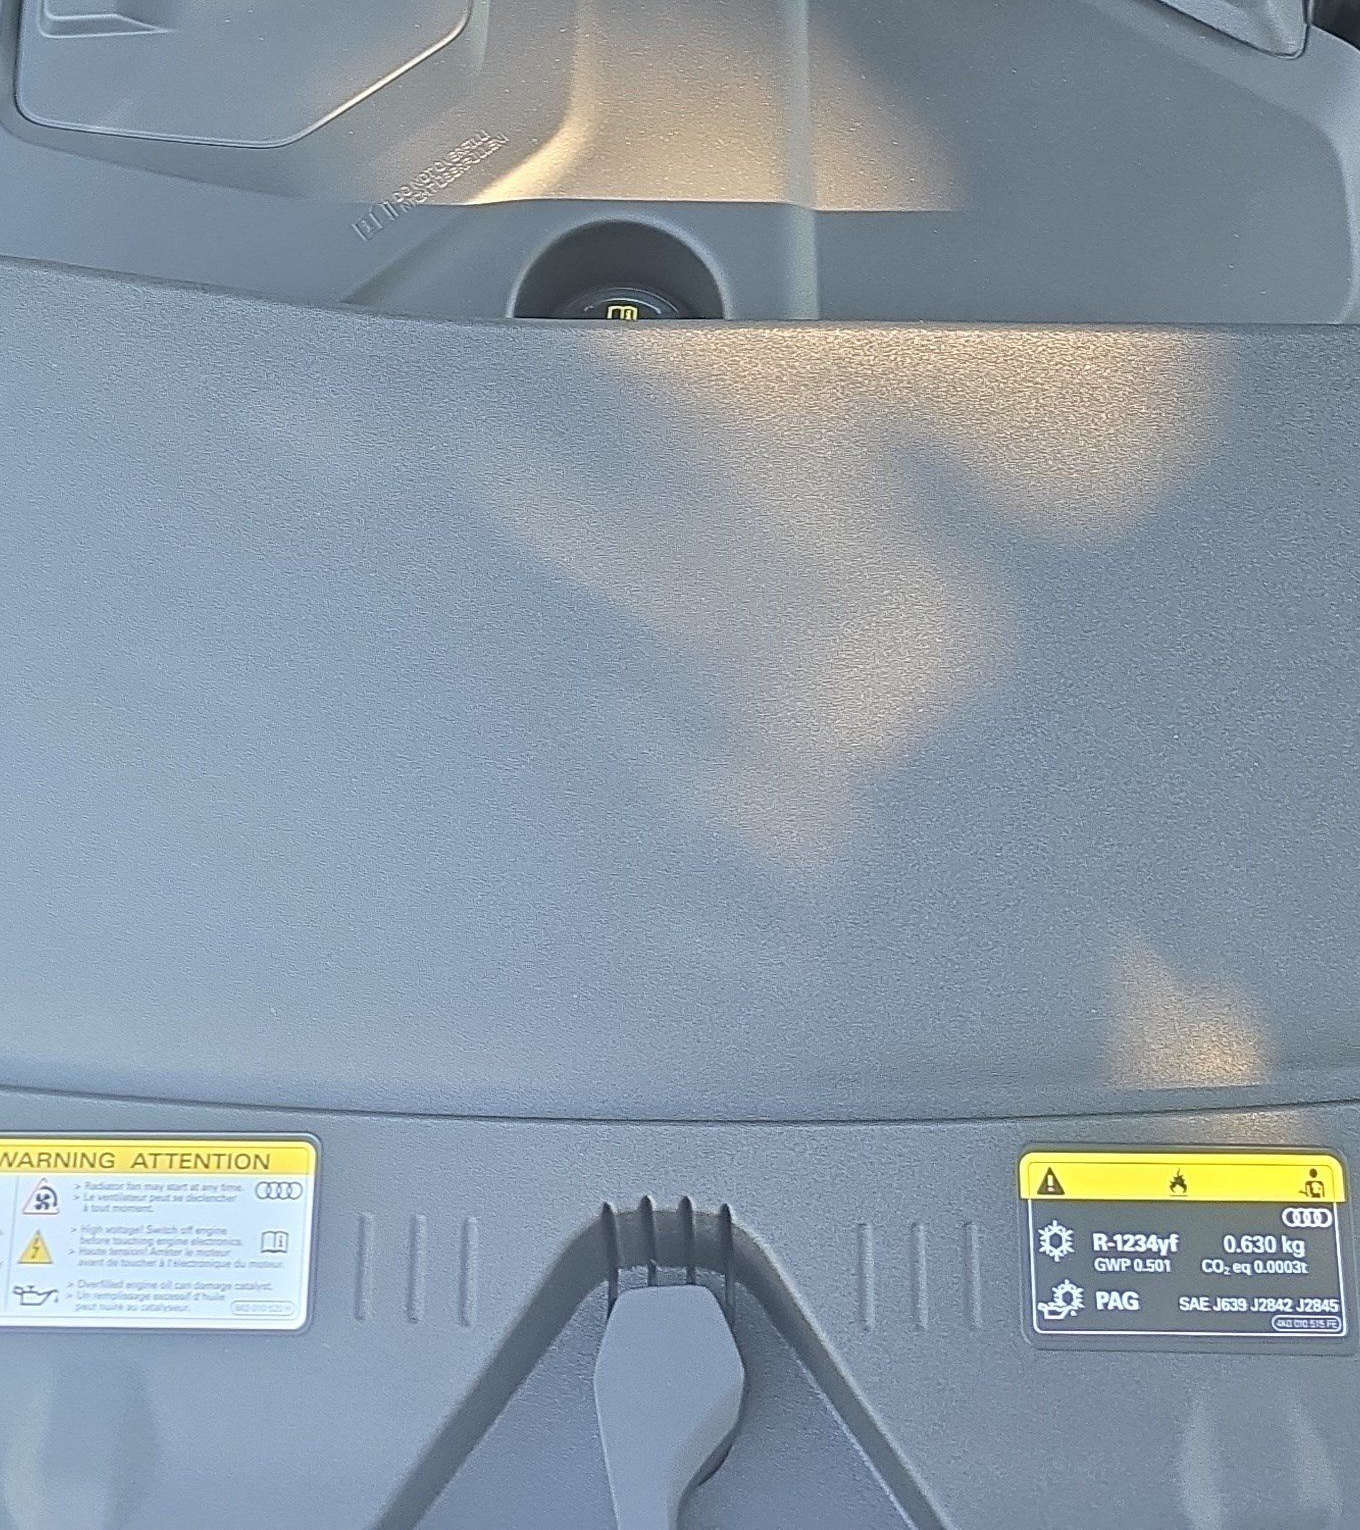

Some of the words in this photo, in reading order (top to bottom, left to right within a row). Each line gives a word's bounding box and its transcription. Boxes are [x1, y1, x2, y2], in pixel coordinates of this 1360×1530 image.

[130, 1152, 270, 1170] ATTENTION
[1093, 1233, 1180, 1257] R-1234yf
[1224, 1235, 1276, 1254] 0.630
[1282, 1235, 1305, 1258] kg
[1094, 1260, 1131, 1273] GWP
[1134, 1260, 1171, 1273] 0.501
[1233, 1262, 1252, 1277] eq
[1095, 1291, 1139, 1311] PAG
[1179, 1297, 1210, 1312] SAE
[1213, 1298, 1247, 1312] J639
[1250, 1298, 1292, 1313] J2842
[1297, 1298, 1339, 1313] J2845
